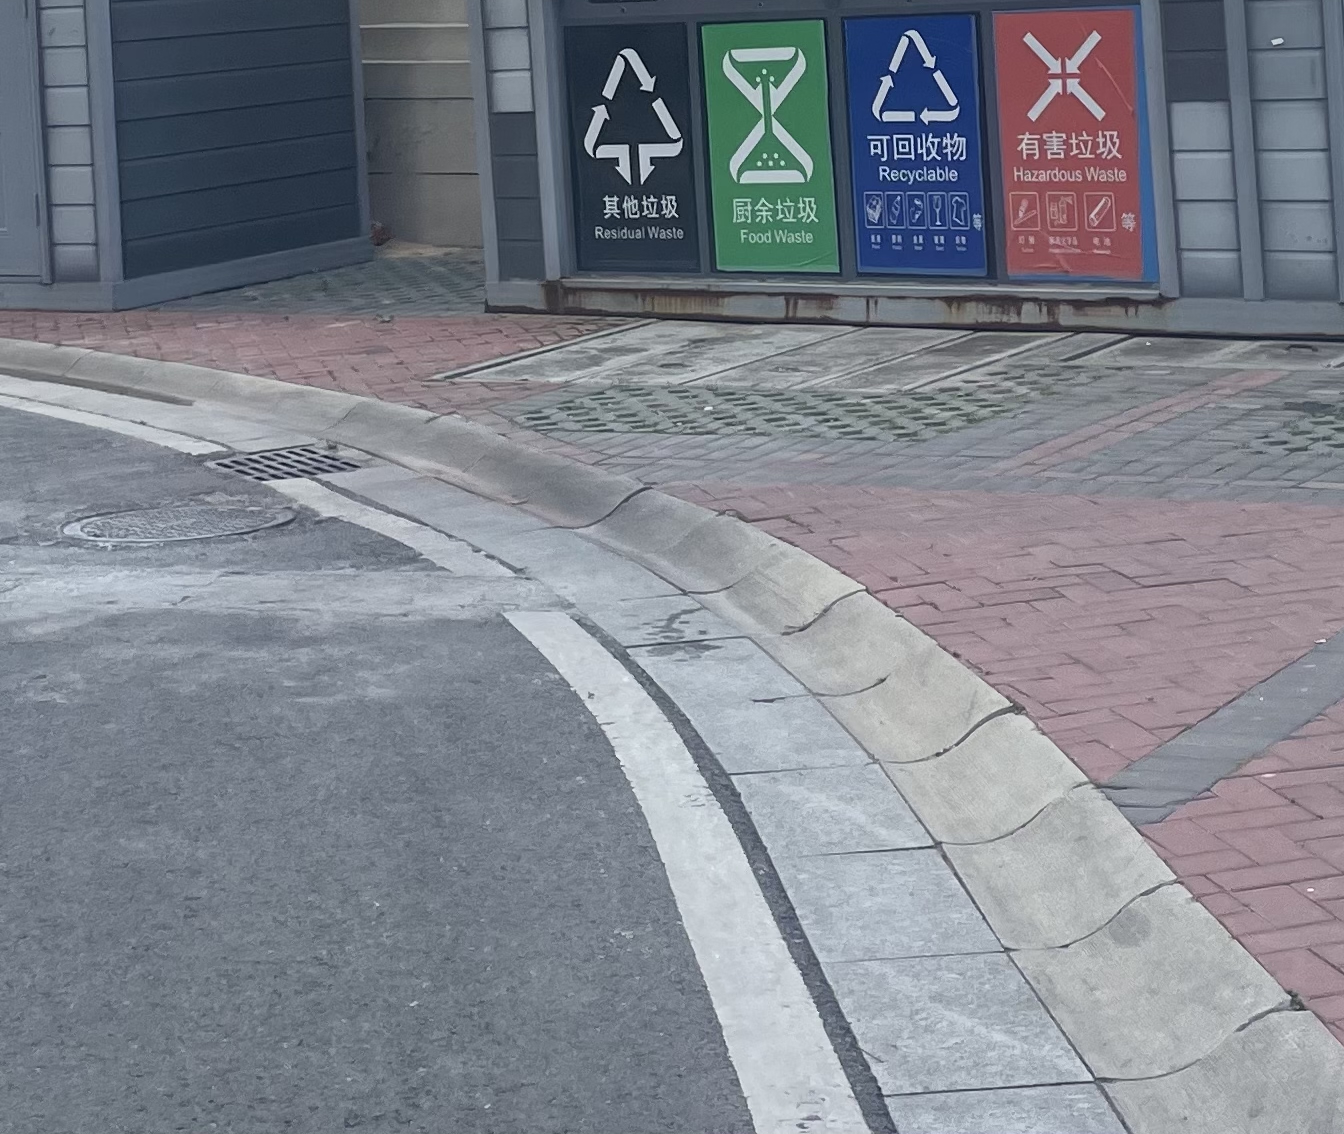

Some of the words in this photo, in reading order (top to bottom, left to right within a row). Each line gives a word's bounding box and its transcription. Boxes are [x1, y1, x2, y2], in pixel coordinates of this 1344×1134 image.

[866, 132, 967, 162] 可回收物
[1016, 130, 1123, 160] 有害垃圾
[879, 165, 959, 185] Recyclable
[1013, 166, 1083, 182] Hazardous
[1084, 166, 1127, 182] Waste
[602, 194, 680, 219] 其他垃圾
[732, 197, 820, 224] 厨余垃圾
[594, 226, 645, 240] Residual
[646, 226, 685, 240] Waste
[740, 229, 772, 244] Food
[773, 229, 814, 244] Waste
